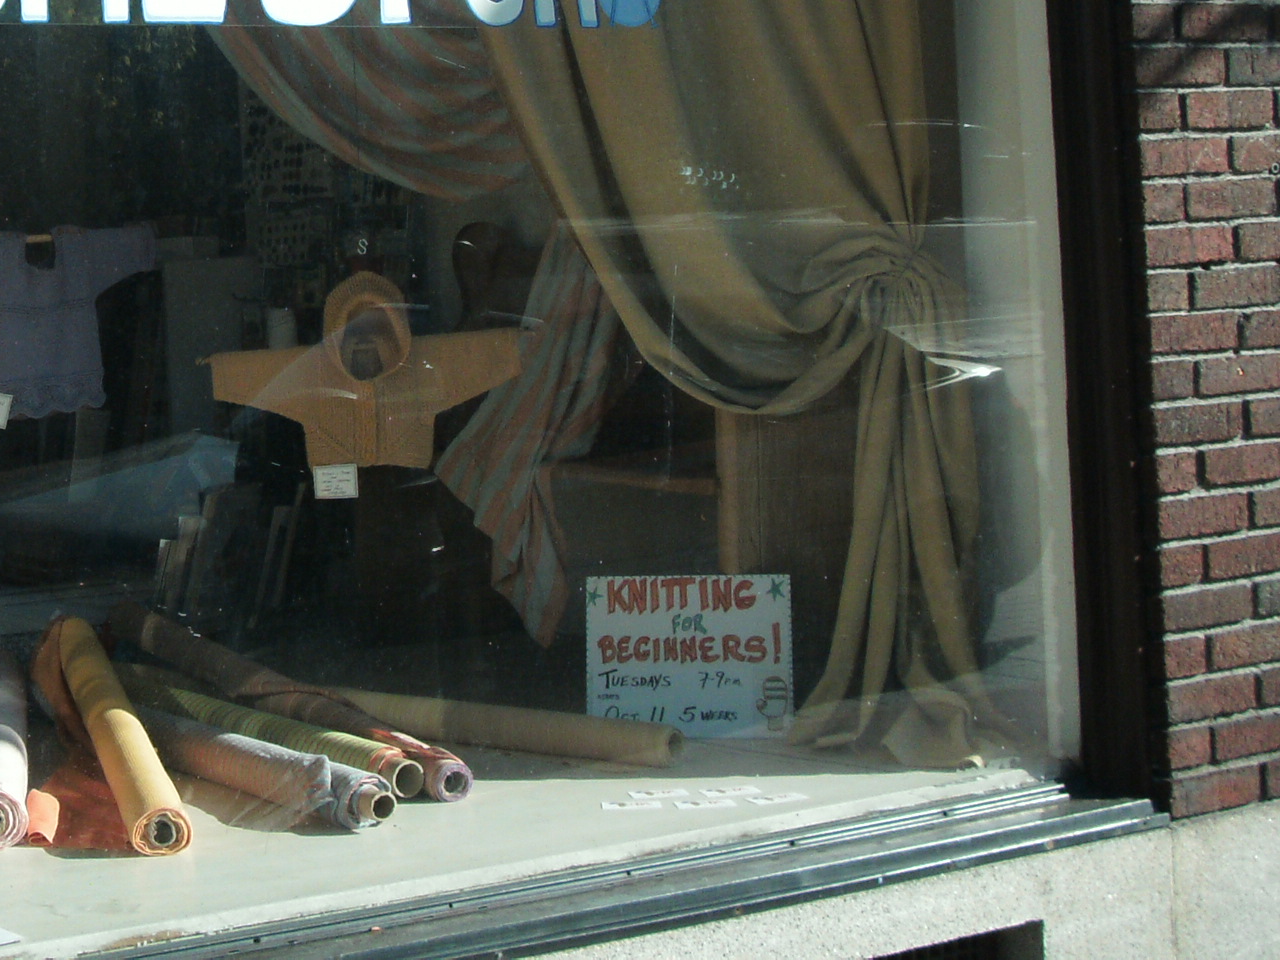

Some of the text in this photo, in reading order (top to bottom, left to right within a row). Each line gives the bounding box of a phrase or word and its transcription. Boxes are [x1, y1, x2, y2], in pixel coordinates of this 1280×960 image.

[606, 577, 757, 615] KNITTING
[671, 613, 708, 634] FOR
[597, 622, 782, 665] BEGINNERS!
[598, 669, 671, 690] TUESDAYS
[678, 705, 697, 723] 5
[700, 708, 738, 723] WEEKS
